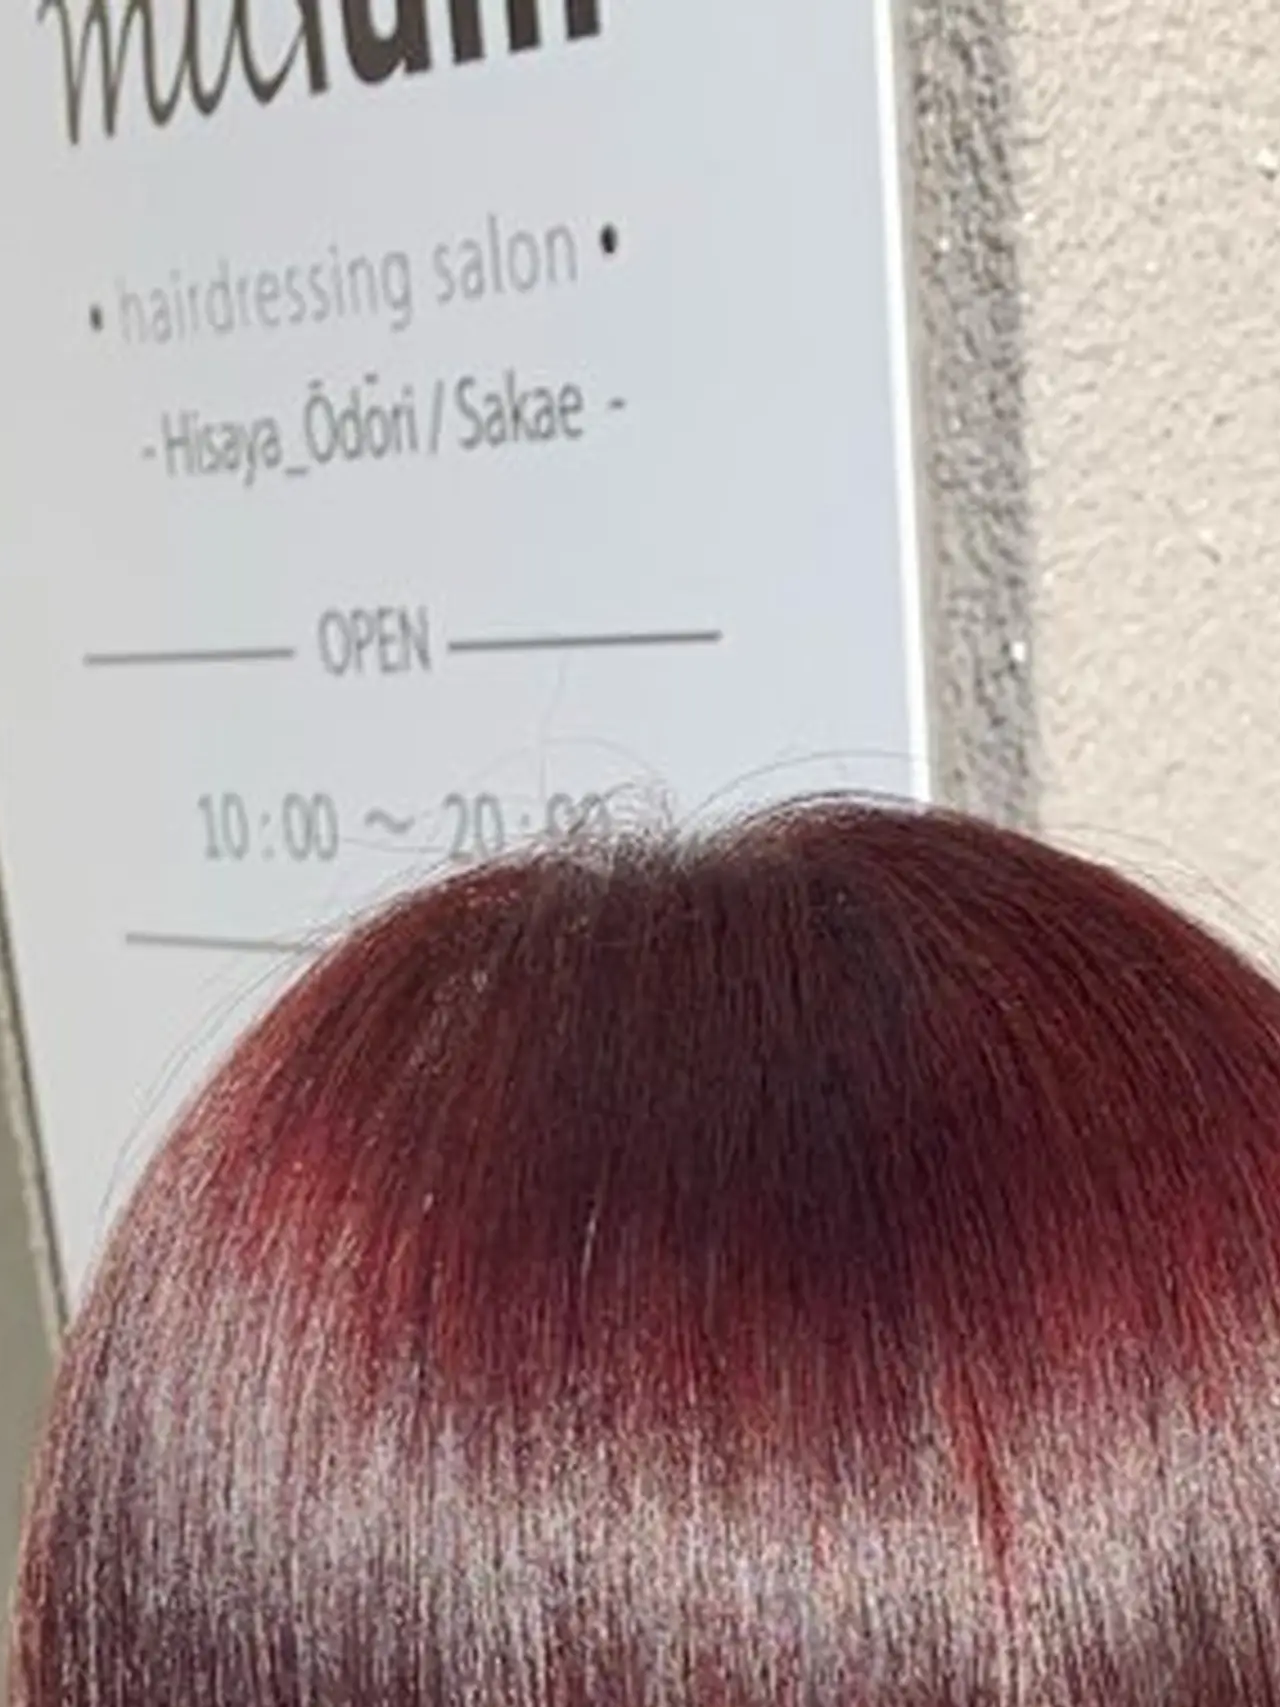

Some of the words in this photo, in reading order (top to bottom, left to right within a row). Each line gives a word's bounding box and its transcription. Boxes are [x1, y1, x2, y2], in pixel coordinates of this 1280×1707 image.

[117, 246, 414, 343] hairdressing
[433, 213, 578, 303] salon
[453, 367, 584, 450] Sakae
[320, 606, 432, 676] OPEN
[196, 792, 340, 861] 10:00
